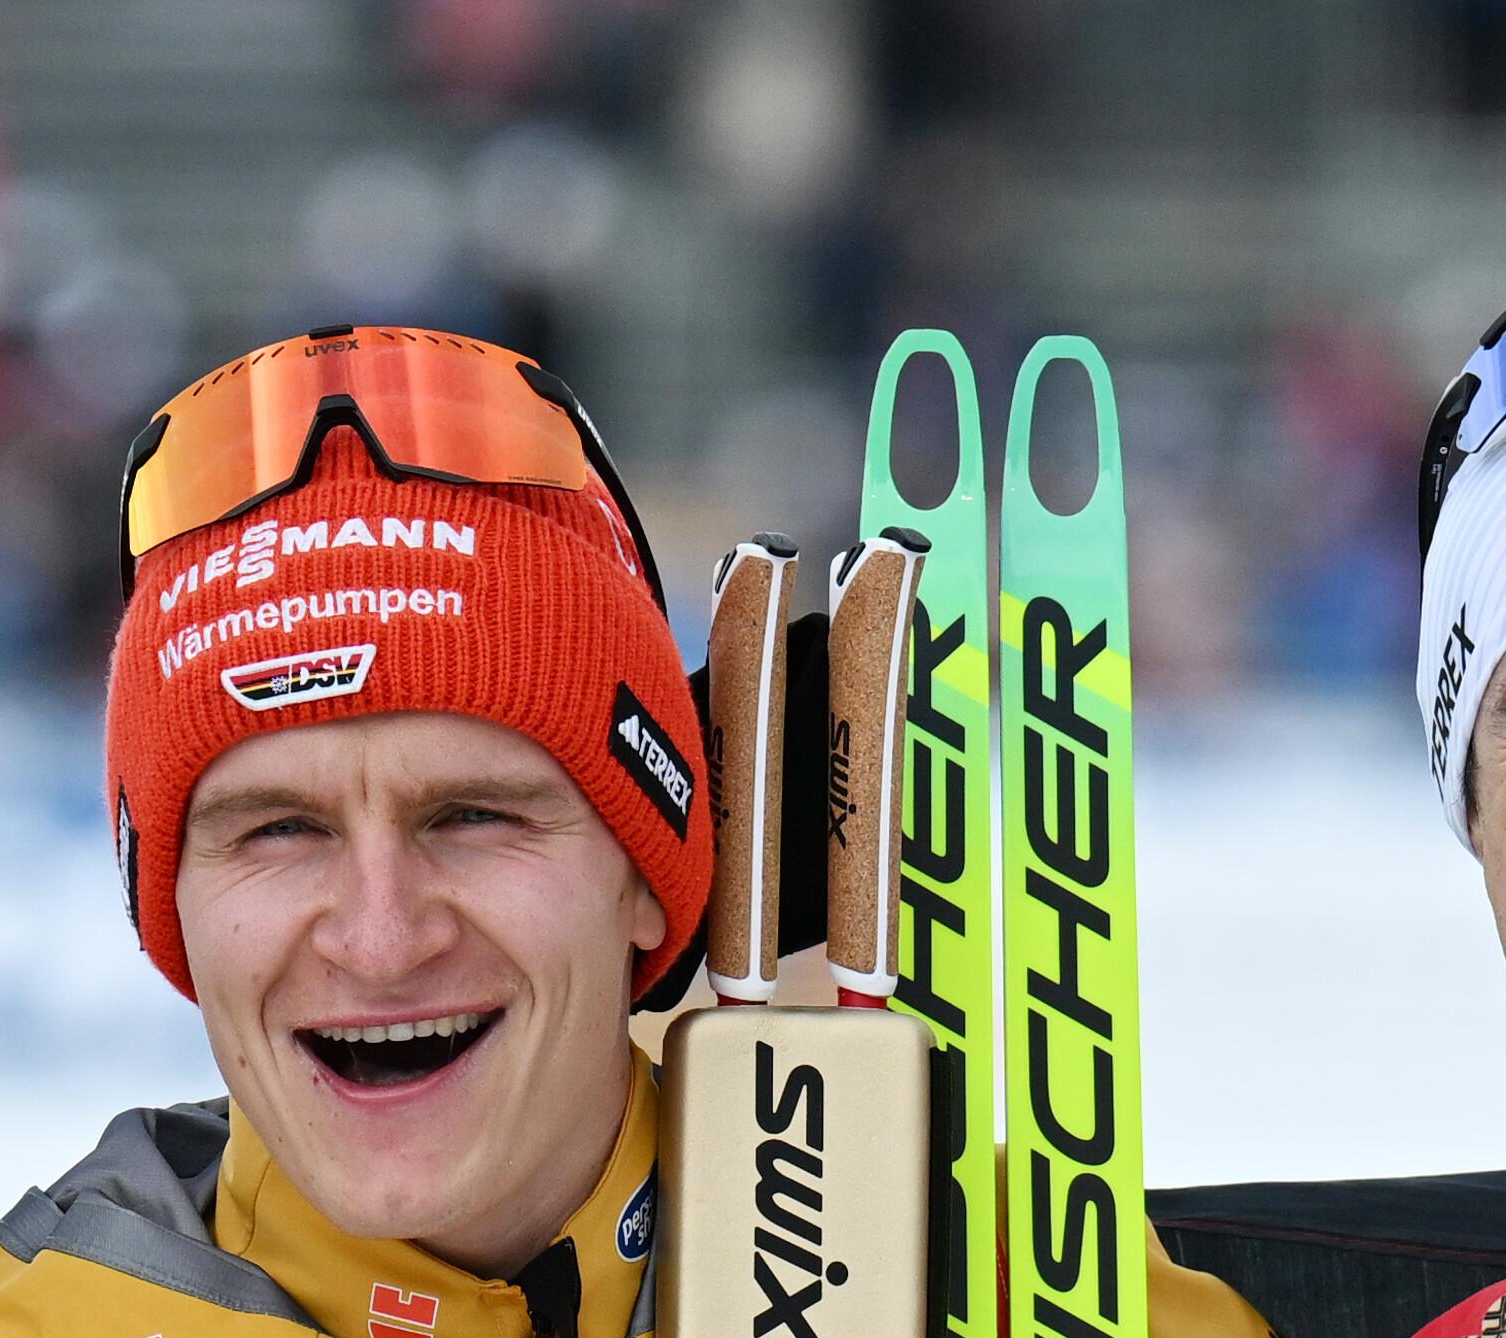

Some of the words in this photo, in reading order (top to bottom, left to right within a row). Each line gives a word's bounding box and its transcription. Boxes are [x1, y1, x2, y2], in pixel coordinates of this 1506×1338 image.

[304, 338, 360, 358] uvex
[159, 516, 476, 614] VIESSMANN
[158, 587, 463, 680] Wärmepumpen
[292, 652, 364, 694] DSV
[1430, 601, 1476, 801] TERREX
[637, 728, 692, 817] TERREX
